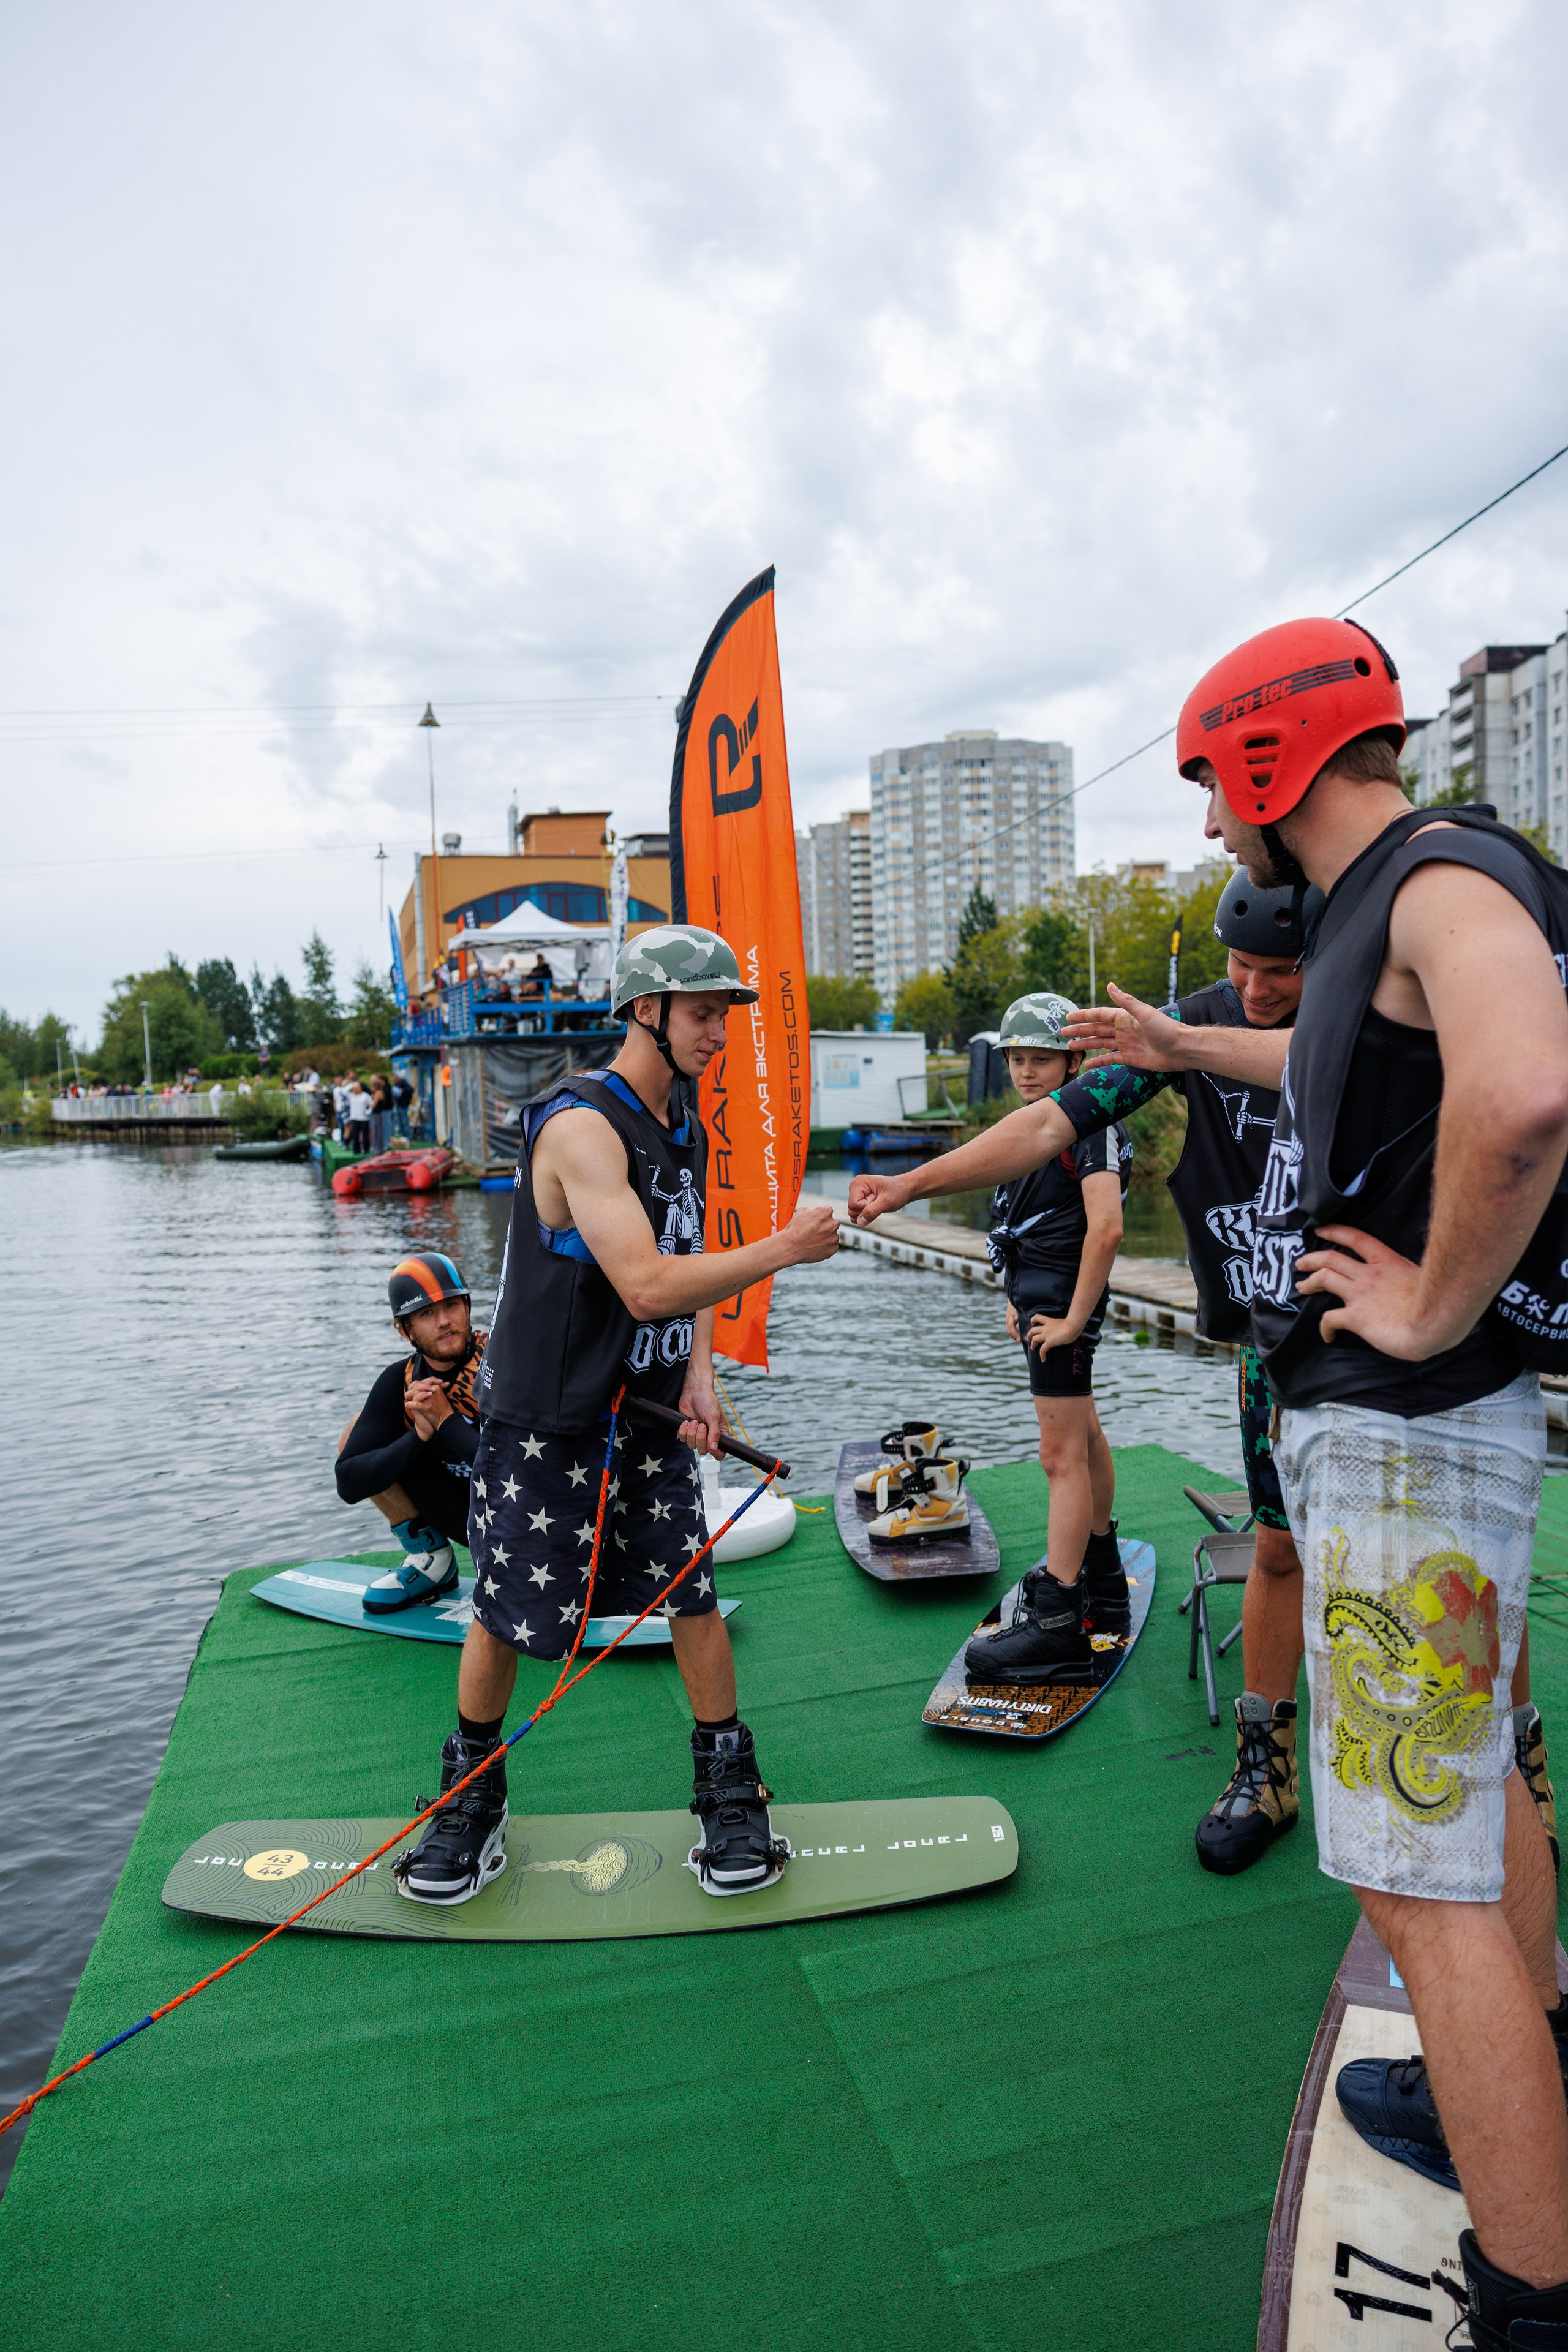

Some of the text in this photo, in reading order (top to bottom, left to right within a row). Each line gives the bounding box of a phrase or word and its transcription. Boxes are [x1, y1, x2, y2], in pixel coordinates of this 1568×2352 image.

[1221, 680, 1293, 724] Pro-tec
[680, 973, 710, 984] sandbox
[756, 1083, 777, 1137] ДЛЯ
[991, 1825, 1006, 1842] 150
[266, 1854, 295, 1864] 43
[256, 1866, 284, 1877] 44
[1441, 2257, 1463, 2271] ING
[1333, 2241, 1432, 2323] 17
